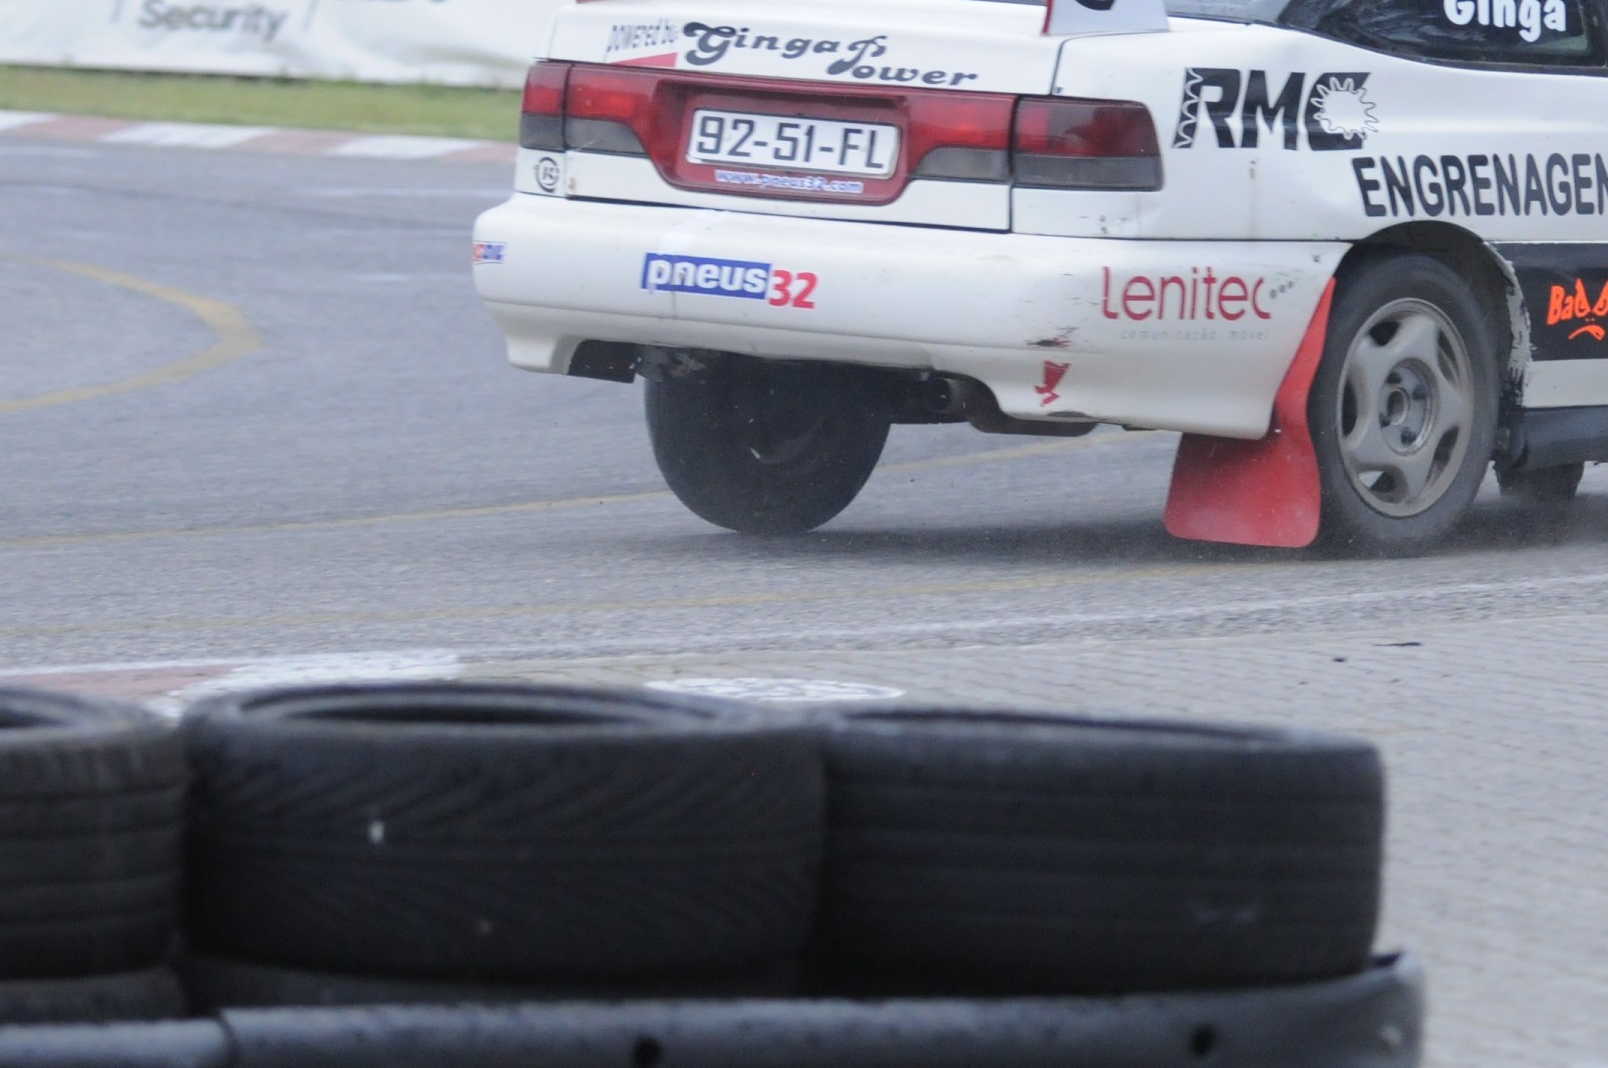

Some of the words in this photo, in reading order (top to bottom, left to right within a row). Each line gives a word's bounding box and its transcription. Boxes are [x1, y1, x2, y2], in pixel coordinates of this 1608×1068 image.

[683, 21, 841, 66] Ginga
[826, 35, 979, 87] Power
[696, 115, 885, 169] 92-51-FL
[1171, 67, 1380, 152] RMC
